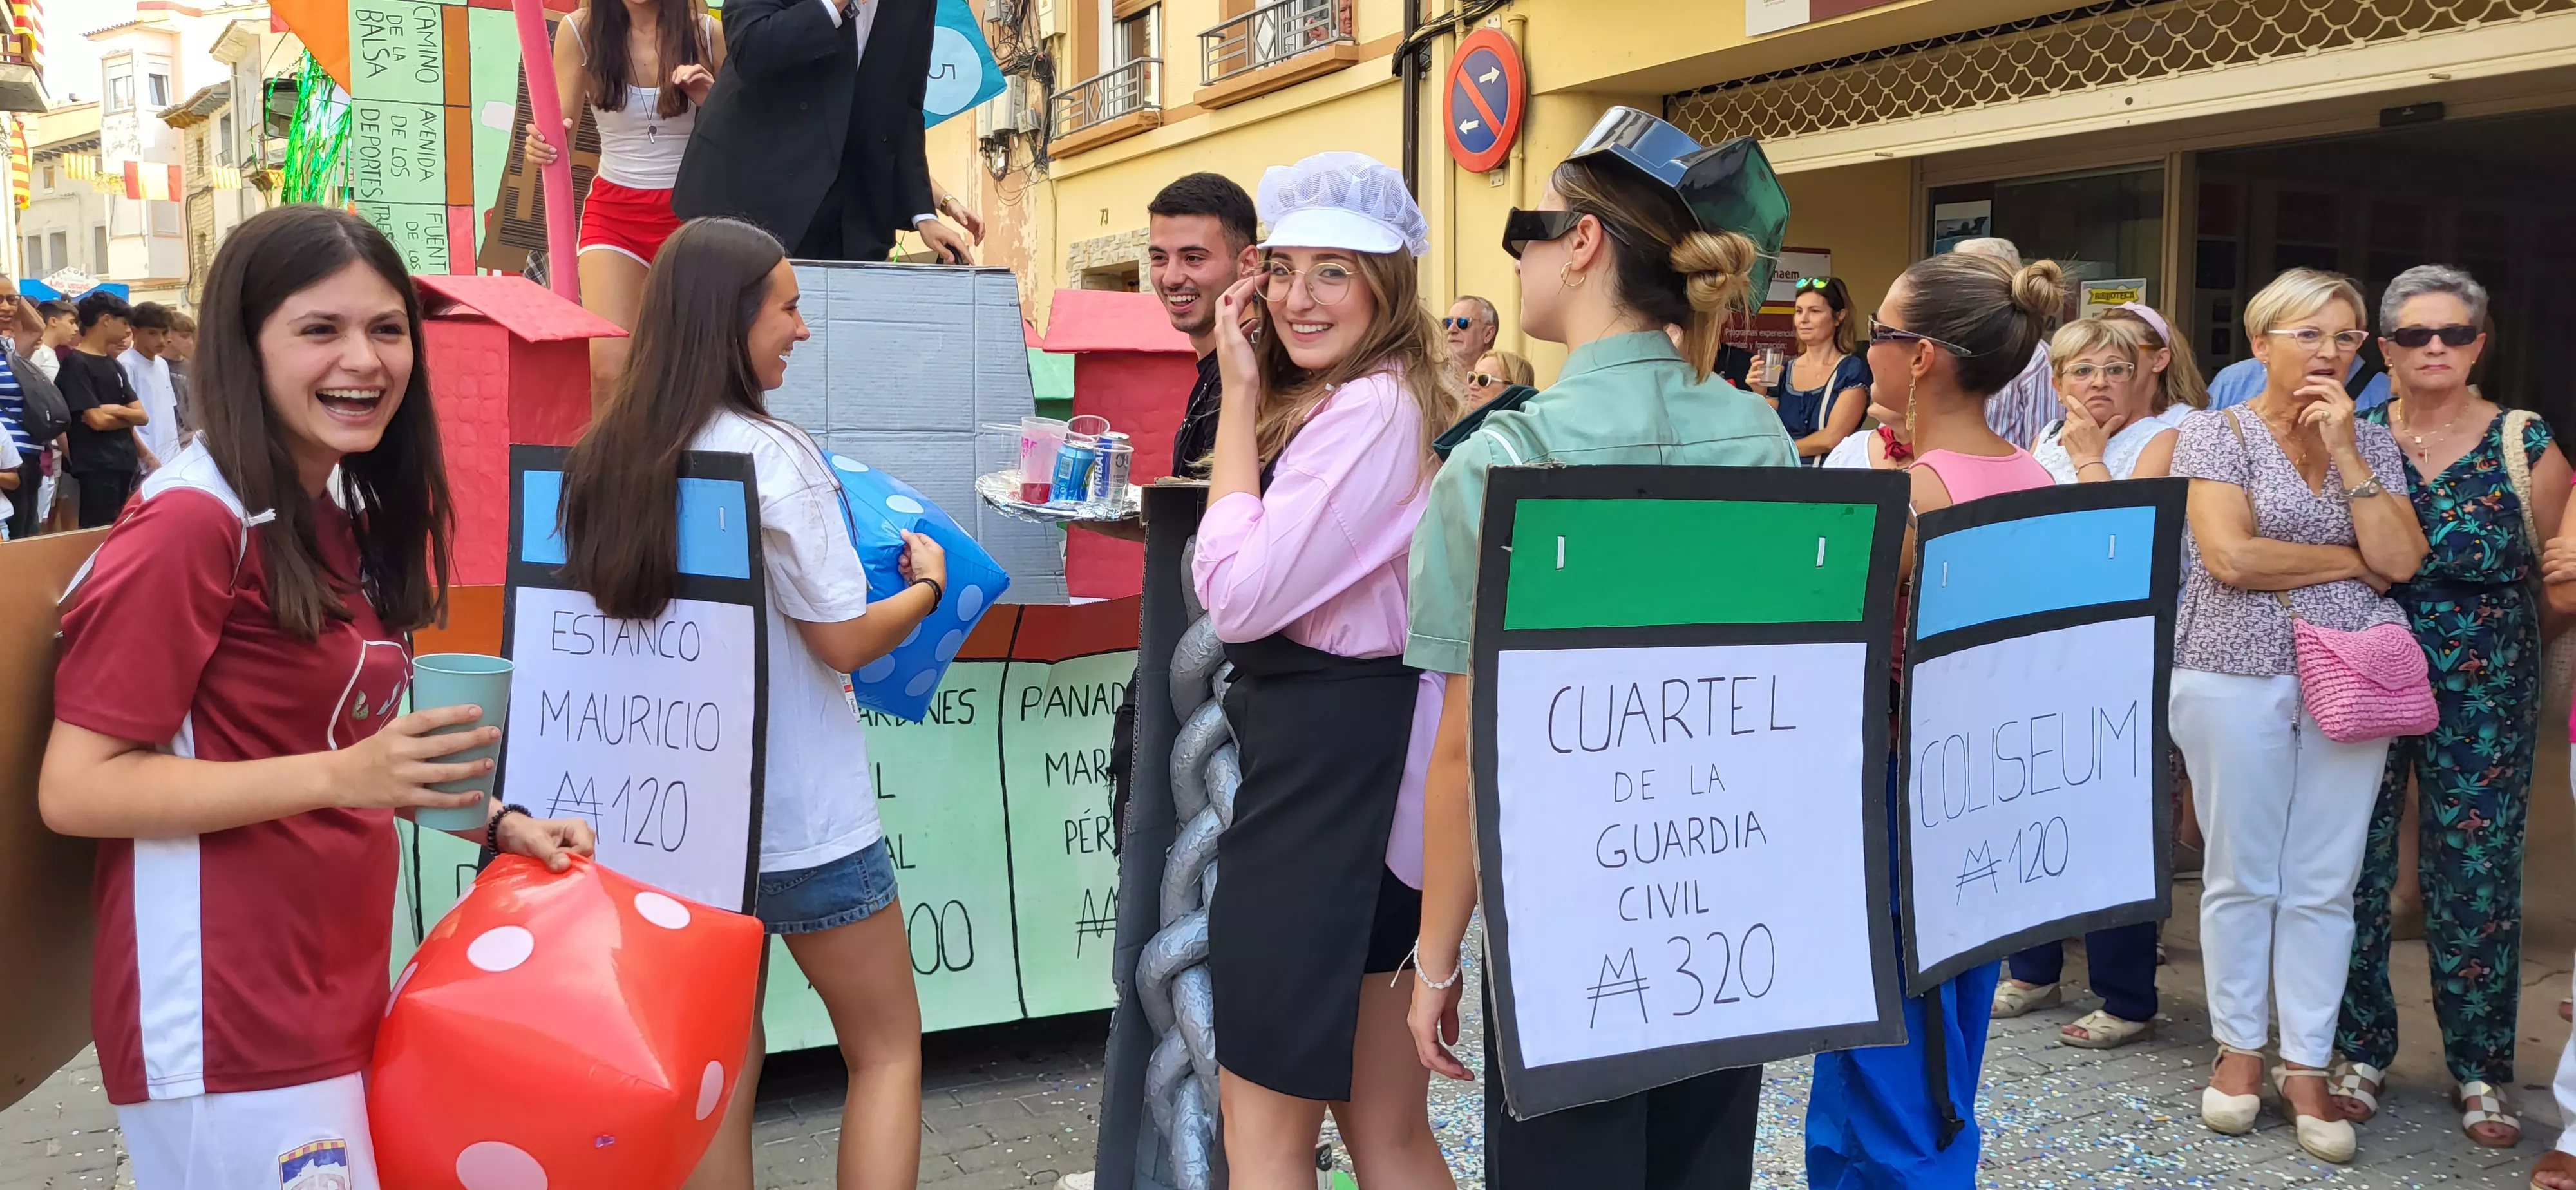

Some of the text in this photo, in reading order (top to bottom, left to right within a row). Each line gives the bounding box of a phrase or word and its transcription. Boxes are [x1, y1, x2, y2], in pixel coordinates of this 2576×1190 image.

[355, 9, 390, 79] BALSA
[386, 15, 407, 62] DE LA
[413, 6, 439, 84] CAMINO
[359, 108, 384, 198] DEPORTES
[390, 115, 410, 177] DE LOS
[417, 108, 438, 182] AVENIDA
[424, 213, 450, 275] FUENT
[1099, 207, 1109, 227] 73
[406, 222, 421, 270] DE LOS
[1774, 270, 1800, 279] naem
[552, 610, 701, 662] ESTANCO
[540, 690, 721, 752] MAURICIO
[1021, 682, 1126, 722] PANAD
[1548, 674, 1797, 754] CUARTEL
[1045, 748, 1108, 788] MAR
[1614, 763, 1725, 803] DE LA
[1920, 699, 2137, 829] COLISEUM
[1065, 808, 1113, 855] PÉR
[1596, 811, 1767, 869] GUARDIA
[1618, 880, 1709, 921] CIVIL
